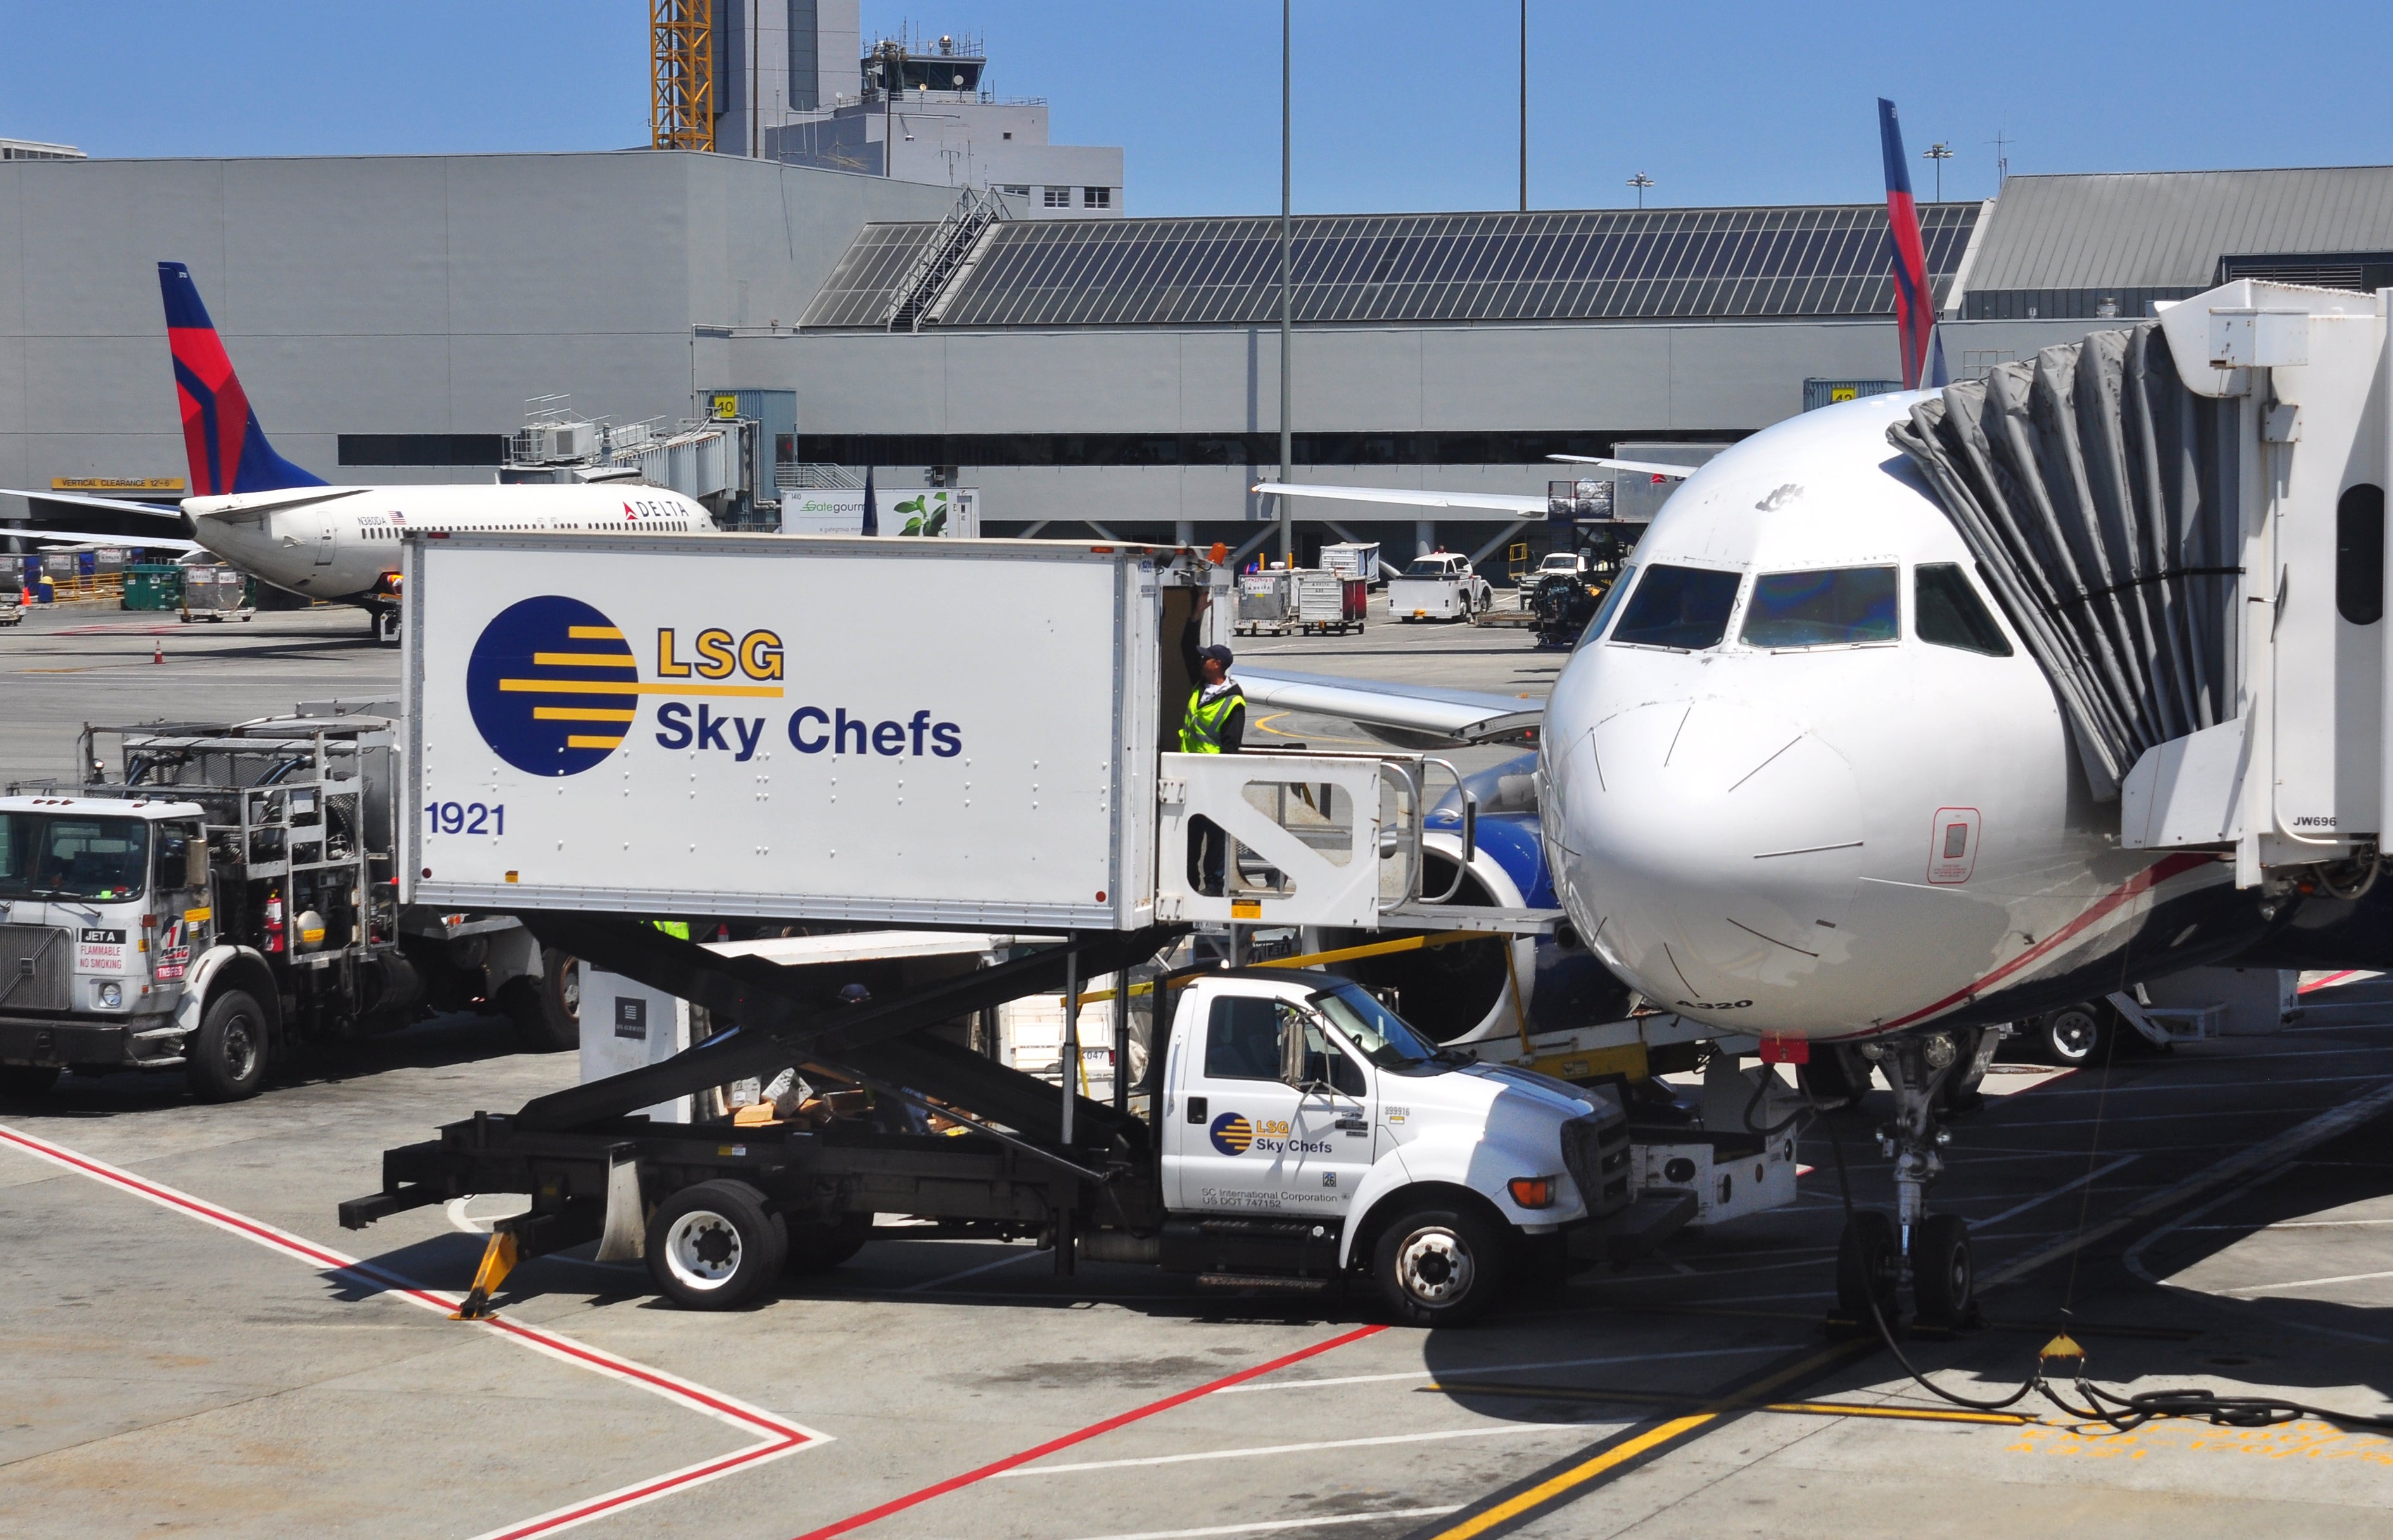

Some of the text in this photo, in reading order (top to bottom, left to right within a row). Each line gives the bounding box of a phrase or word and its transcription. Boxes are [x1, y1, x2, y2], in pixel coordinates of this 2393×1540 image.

[717, 401, 733, 412] 40
[635, 501, 689, 517] DELTA
[357, 516, 387, 526] N380DA
[657, 628, 784, 681] LSG
[656, 702, 962, 761] Sky Chefs
[424, 802, 504, 835] 1921
[2293, 817, 2337, 826] JW696
[86, 931, 115, 942] JET A
[80, 945, 121, 956] FLAMMABLE
[80, 958, 122, 969] NO SMOKING
[1676, 1000, 1753, 1009] A320
[1256, 1120, 1288, 1133] LSG
[1257, 1139, 1332, 1153] Sky Chefs
[1202, 1187, 1337, 1202] SC International Corporation
